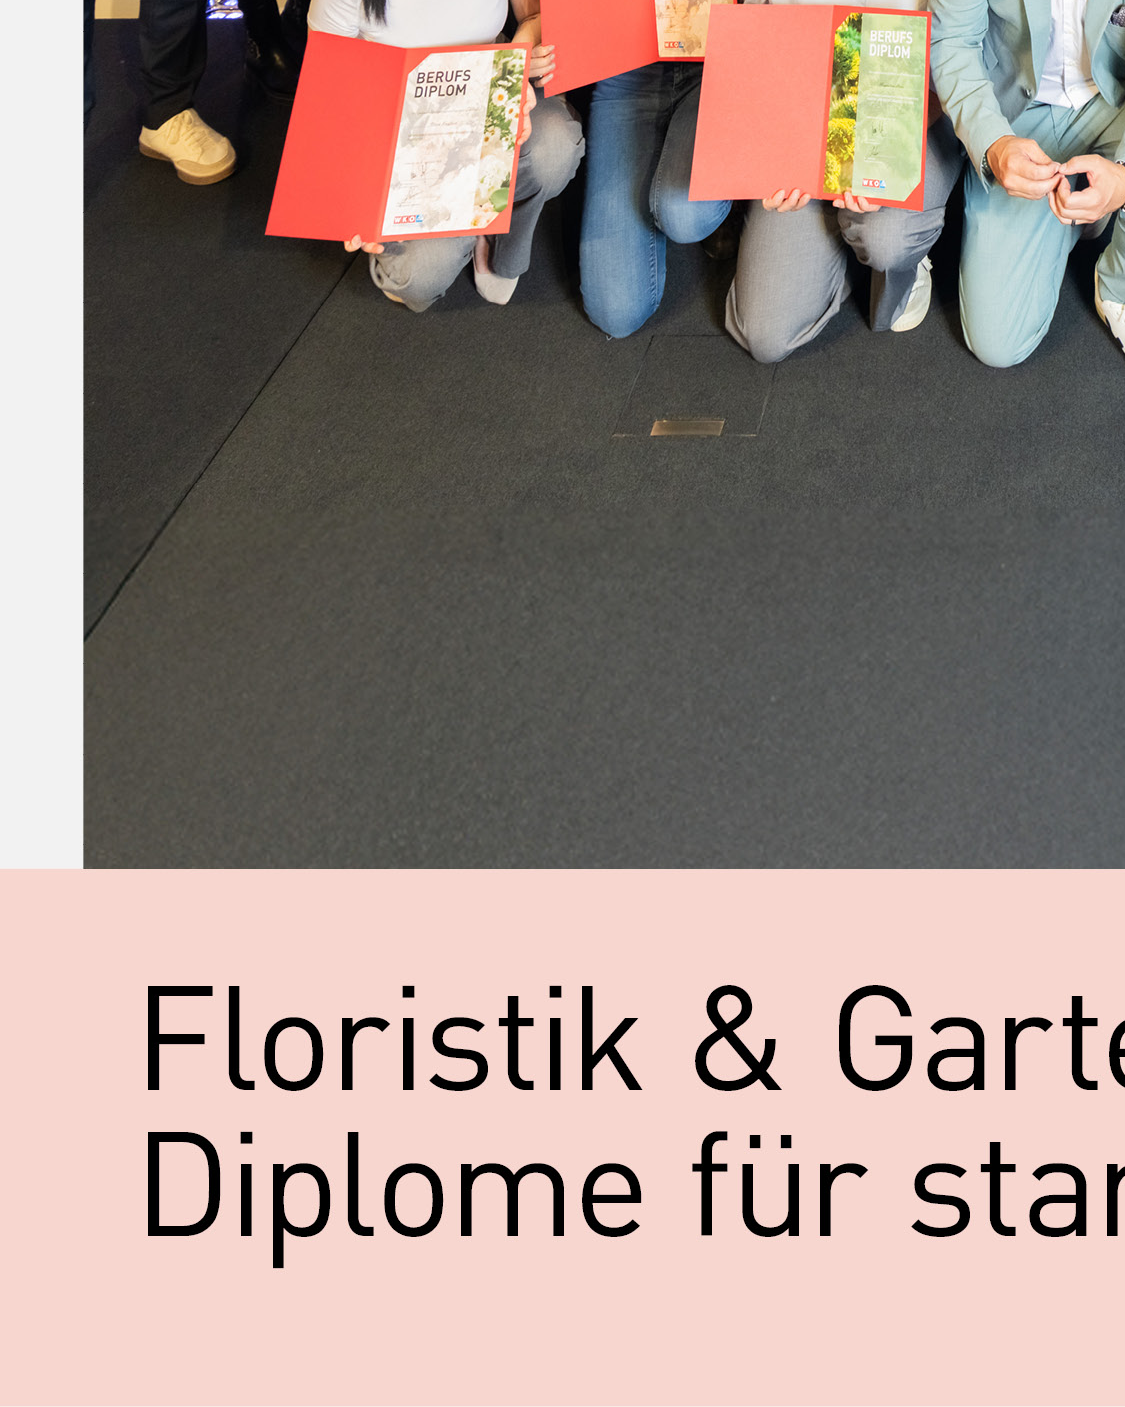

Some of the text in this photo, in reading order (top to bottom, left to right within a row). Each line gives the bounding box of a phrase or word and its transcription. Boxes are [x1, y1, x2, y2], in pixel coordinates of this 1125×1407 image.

[870, 30, 913, 44] BERUFS
[869, 44, 910, 59] DIPLOM
[416, 69, 471, 84] BERUFS
[414, 84, 467, 98] DIPLOM
[863, 178, 880, 188] WKO
[394, 215, 415, 224] WKO
